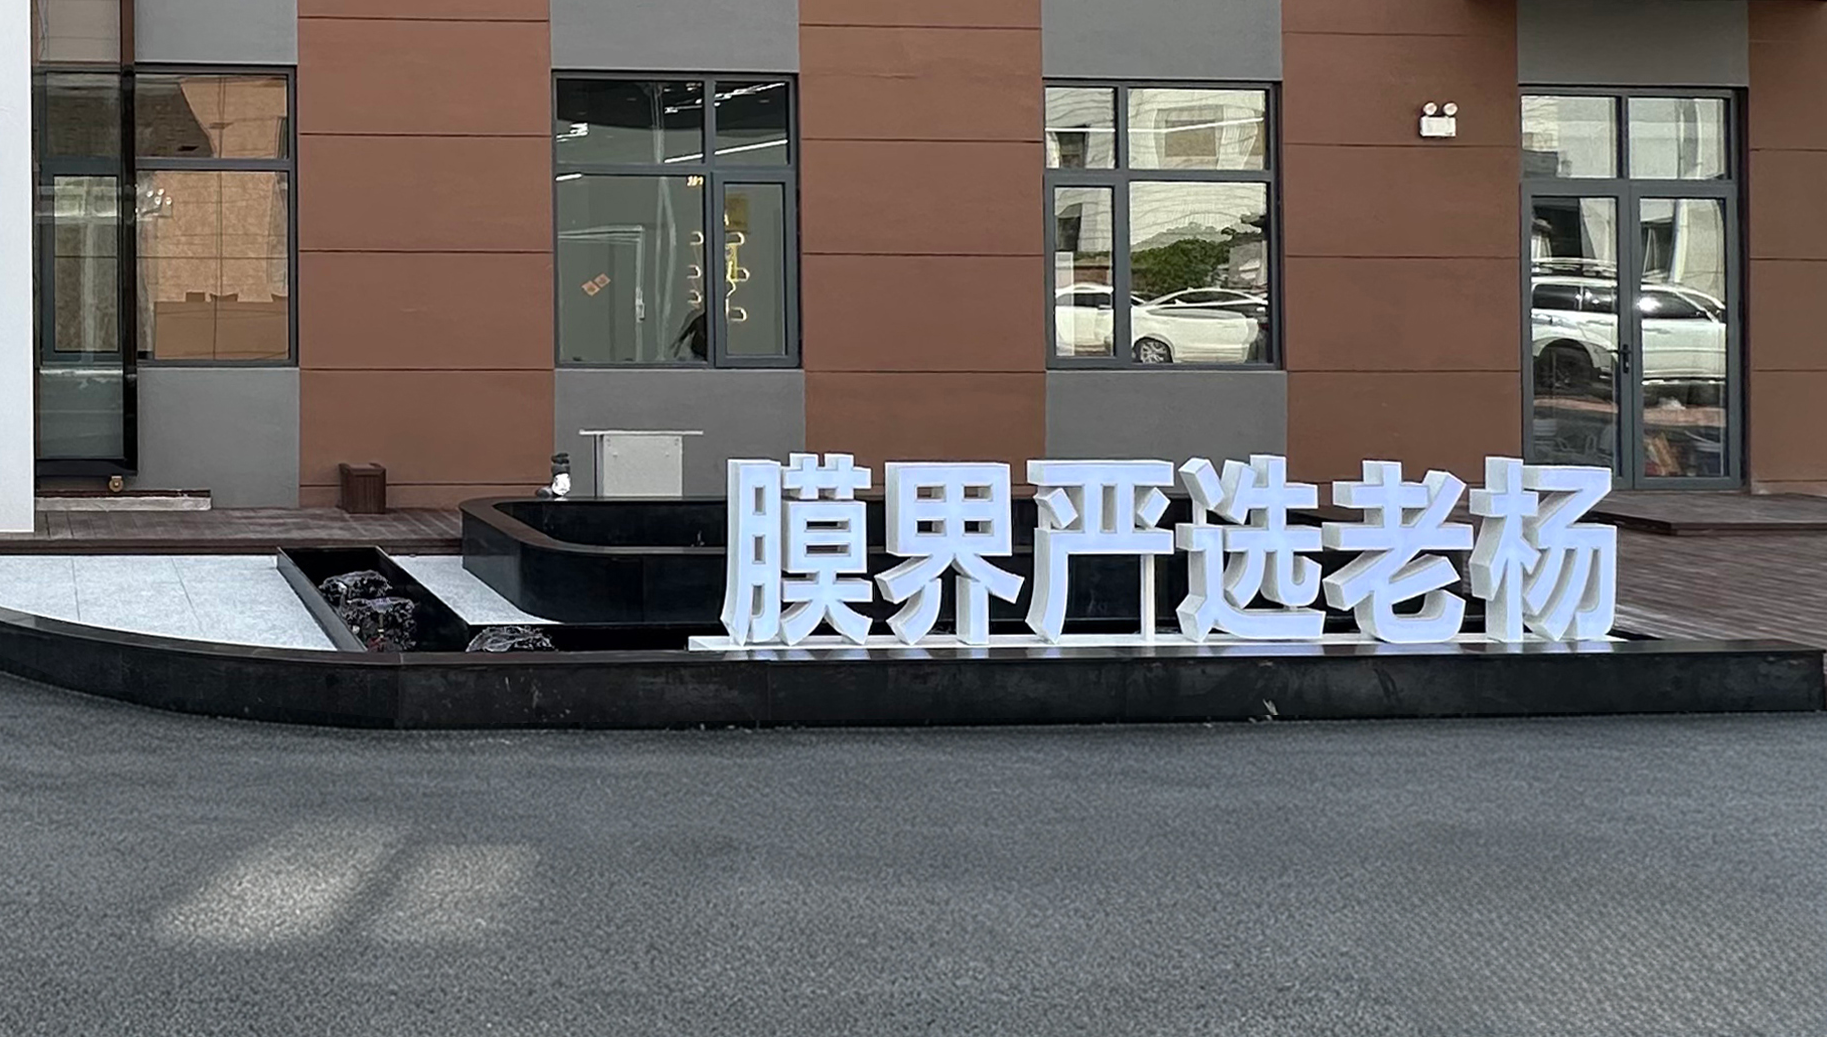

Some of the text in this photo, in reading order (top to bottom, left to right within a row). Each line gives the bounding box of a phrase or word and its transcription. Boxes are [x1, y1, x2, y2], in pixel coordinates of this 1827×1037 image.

[720, 453, 1616, 644] 膜界严选老杨
